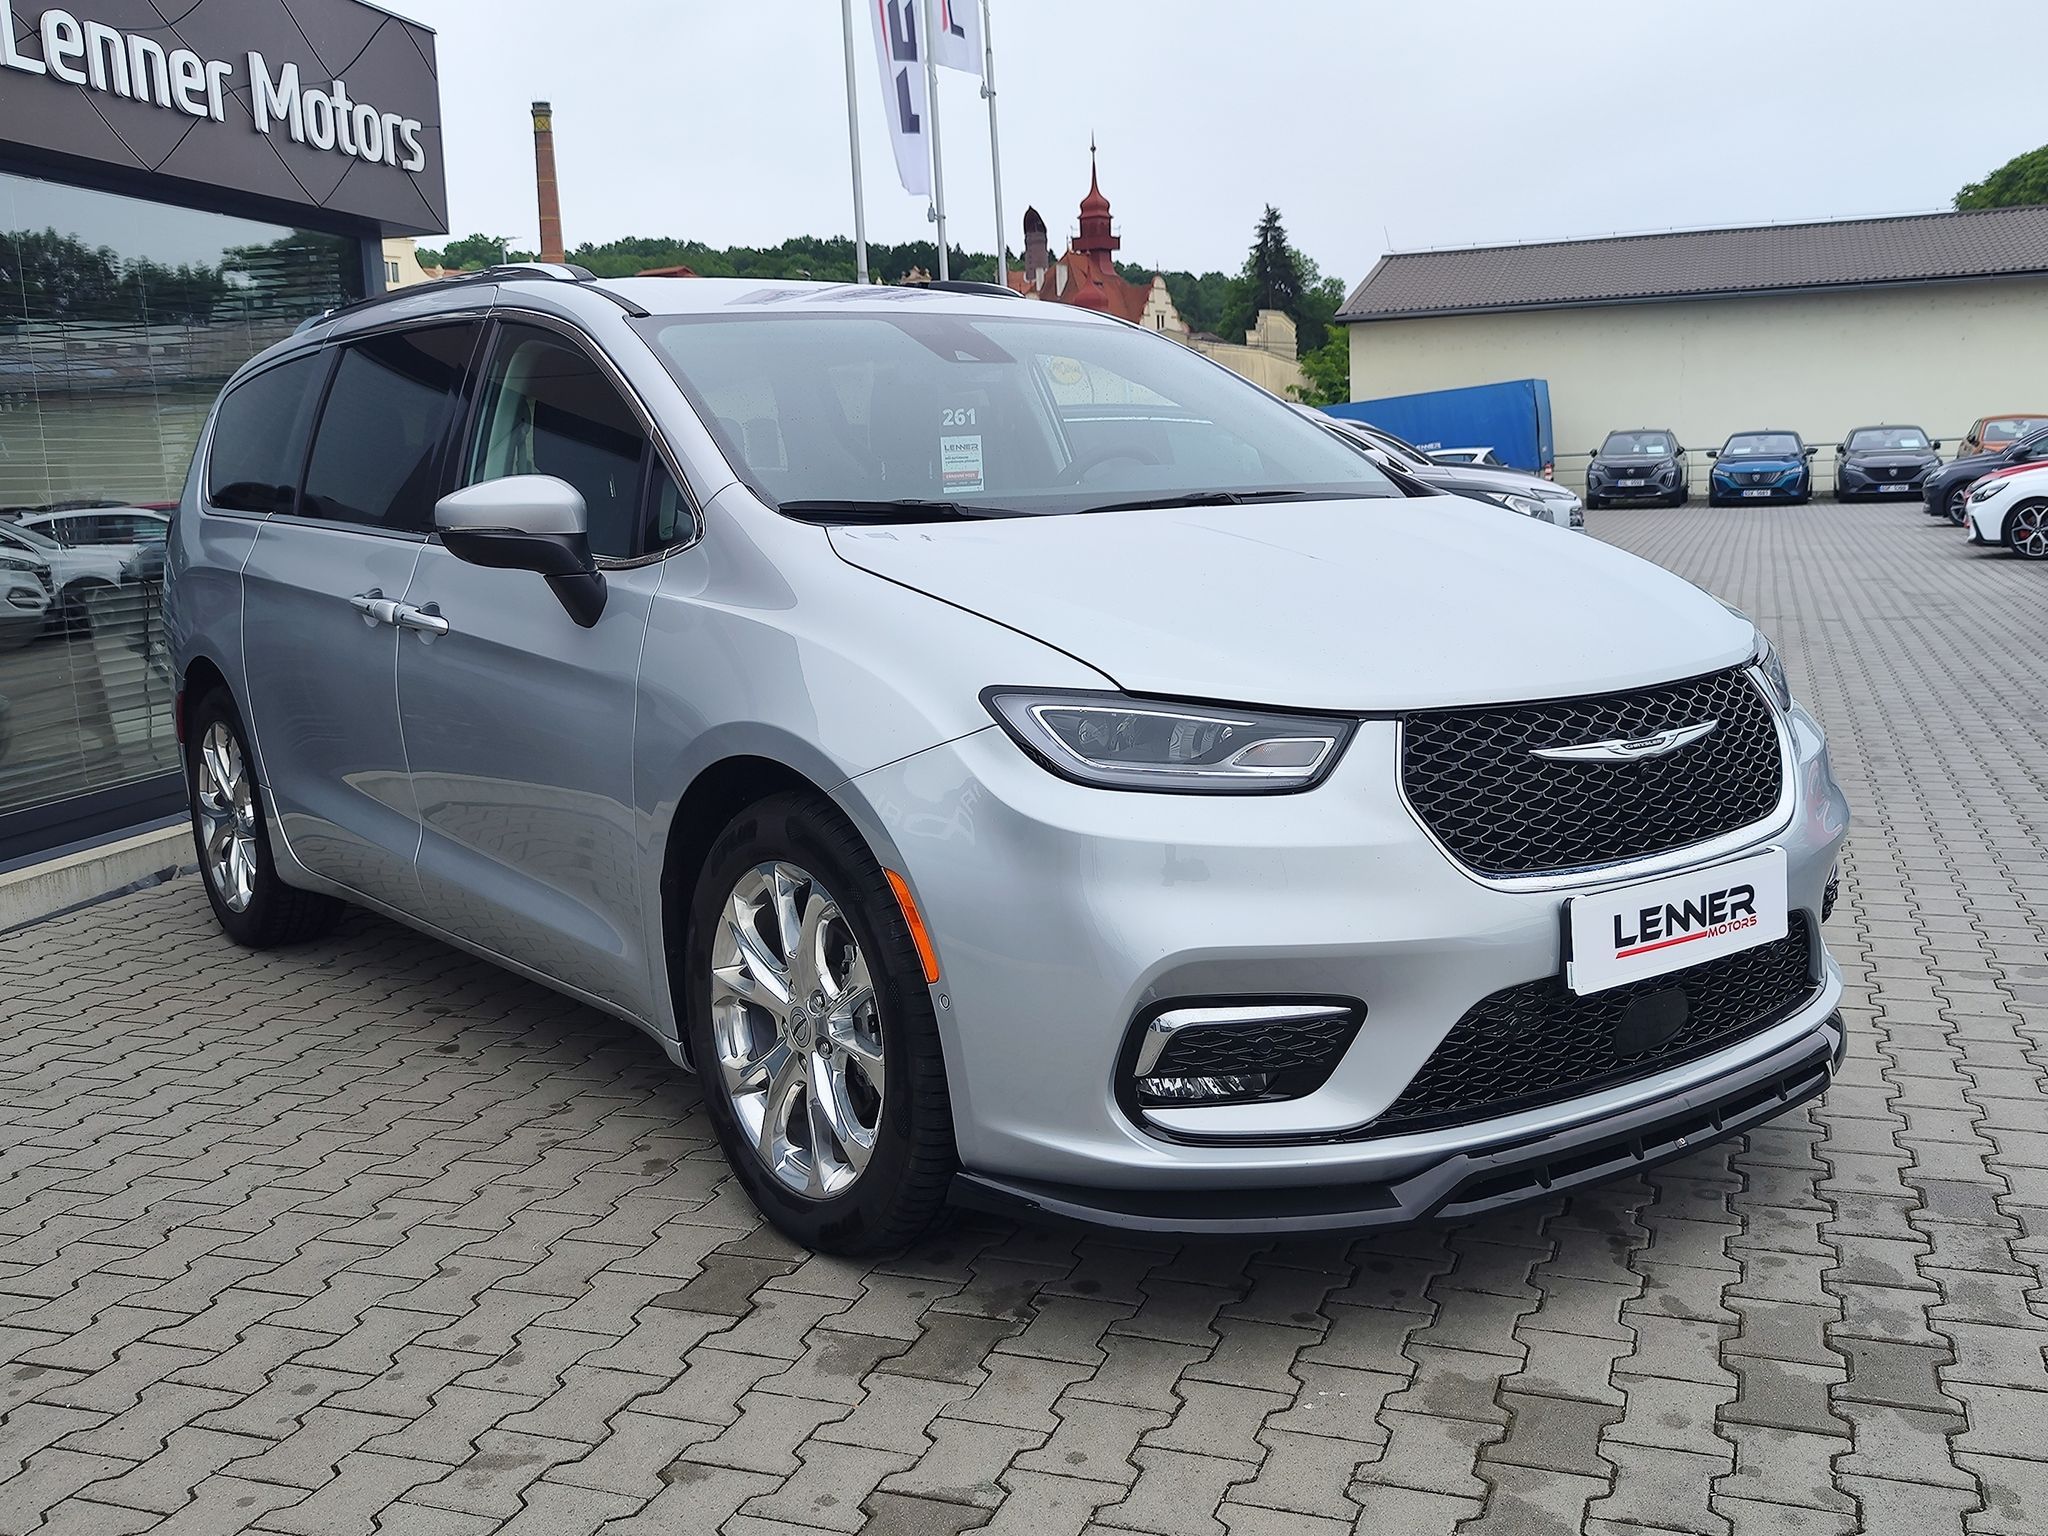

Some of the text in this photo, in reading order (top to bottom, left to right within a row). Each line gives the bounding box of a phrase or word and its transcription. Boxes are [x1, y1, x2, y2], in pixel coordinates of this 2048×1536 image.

[0, 0, 426, 172] Lenner Motors
[942, 407, 976, 426] 261
[1625, 738, 1663, 749] CHRYSLER
[1614, 884, 1757, 949] LENNER
[1707, 915, 1758, 938] MOTORS
